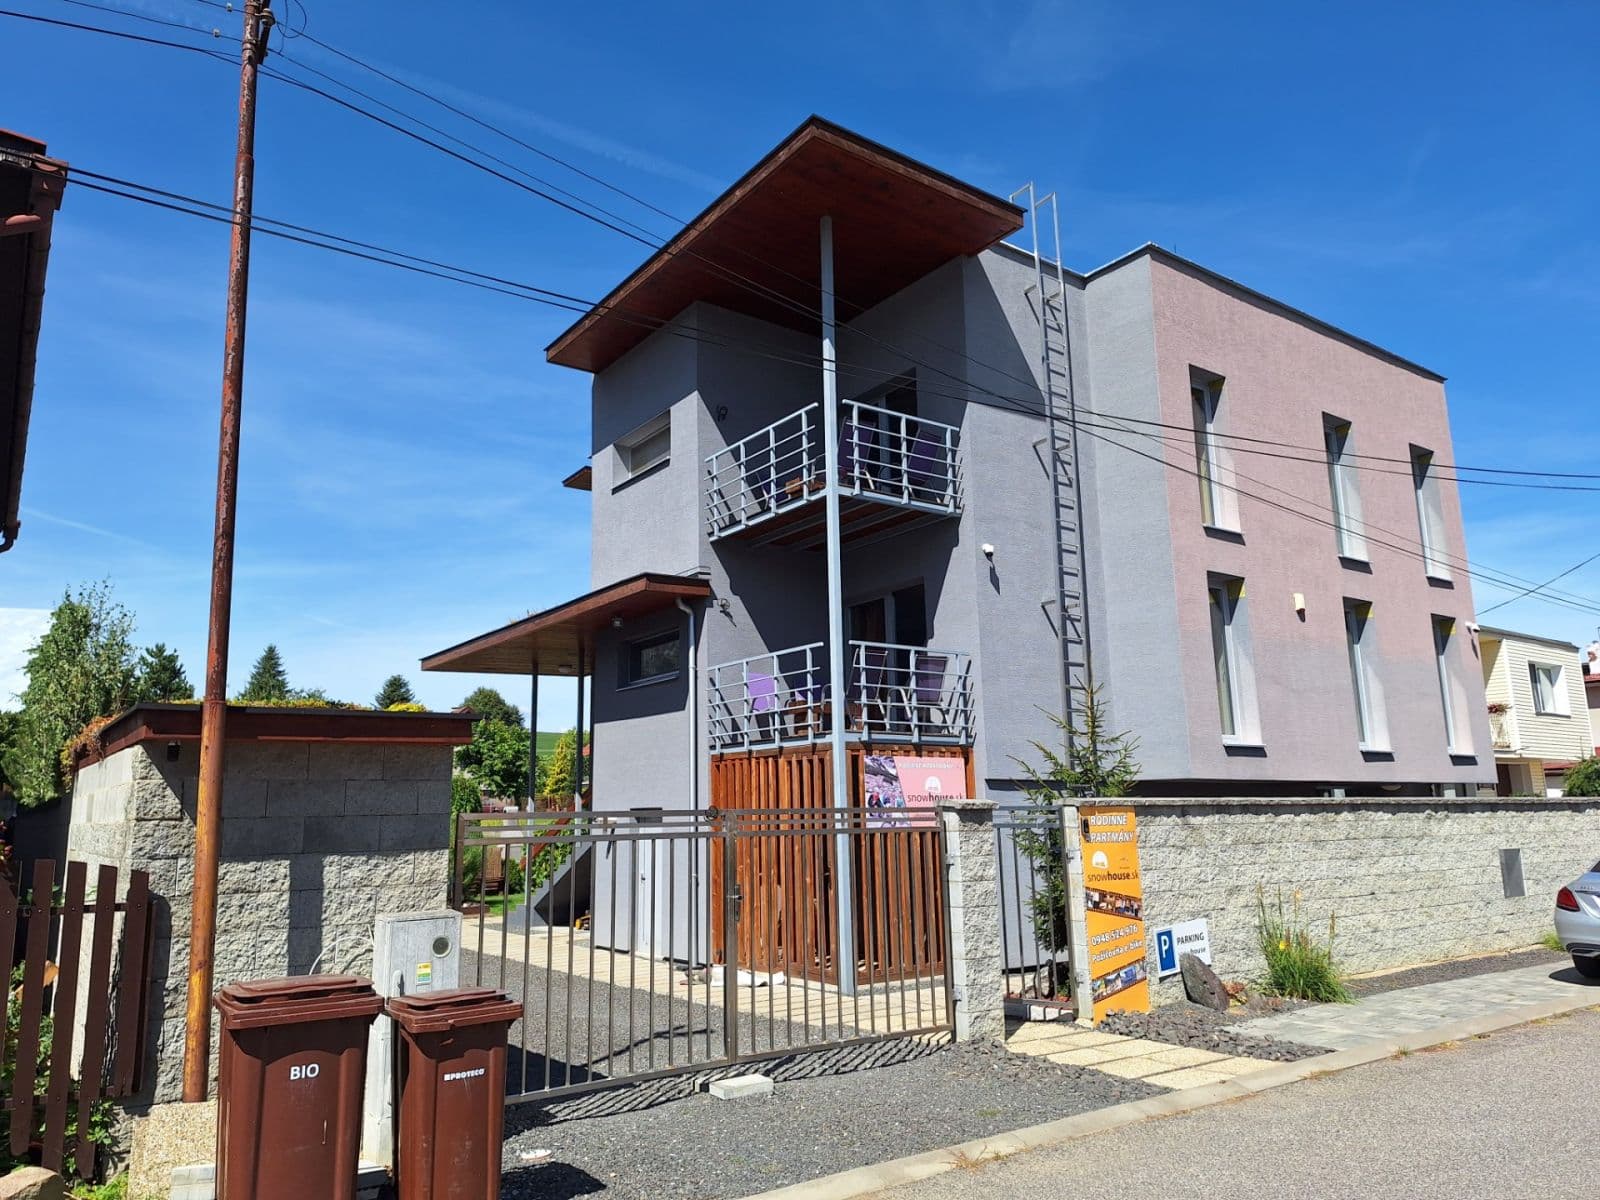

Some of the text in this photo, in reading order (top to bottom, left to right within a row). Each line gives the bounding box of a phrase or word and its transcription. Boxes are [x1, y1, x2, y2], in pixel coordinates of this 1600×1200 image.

[907, 792, 962, 802] snowhousesk
[1088, 830, 1134, 842] PARTMÁNY
[1091, 932, 1109, 945] 0948
[1176, 932, 1204, 945] PARKING
[1160, 935, 1169, 958] P
[290, 1063, 320, 1080] BIO
